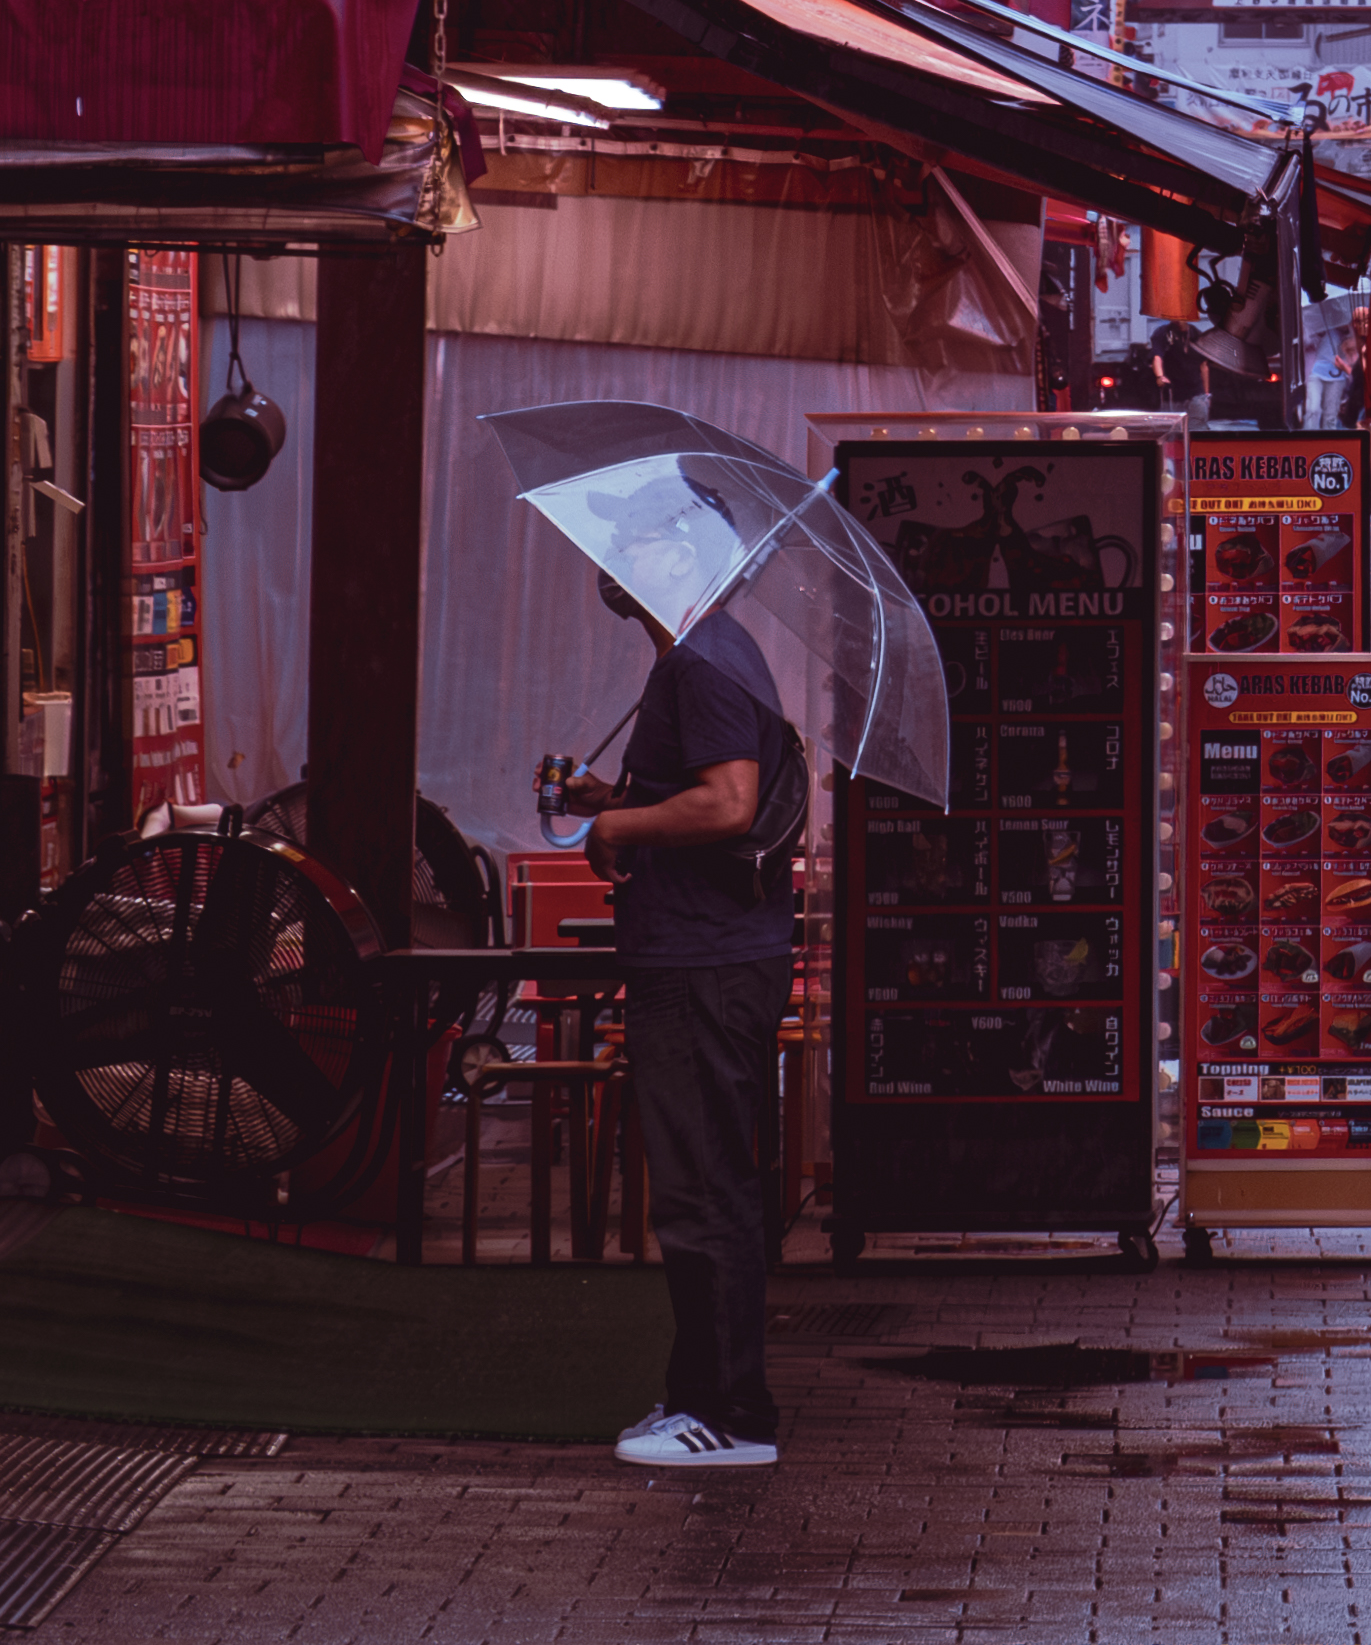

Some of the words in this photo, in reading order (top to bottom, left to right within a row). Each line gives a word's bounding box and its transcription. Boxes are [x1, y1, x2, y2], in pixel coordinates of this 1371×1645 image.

[1239, 455, 1308, 480] KEBAB
[1313, 473, 1349, 490] No.1
[861, 472, 917, 521] 酒
[1027, 592, 1125, 617] MENU
[1241, 675, 1285, 694] ARAS
[1289, 675, 1345, 694] KEBAB
[1105, 725, 1120, 771] コロナ
[1203, 742, 1258, 760] Menu
[1105, 1016, 1120, 1076] 白ワイン
[1200, 1063, 1270, 1076] Topping
[1043, 1080, 1083, 1093] White
[1085, 1080, 1120, 1093] Wine
[1200, 1106, 1255, 1118] Sauce
